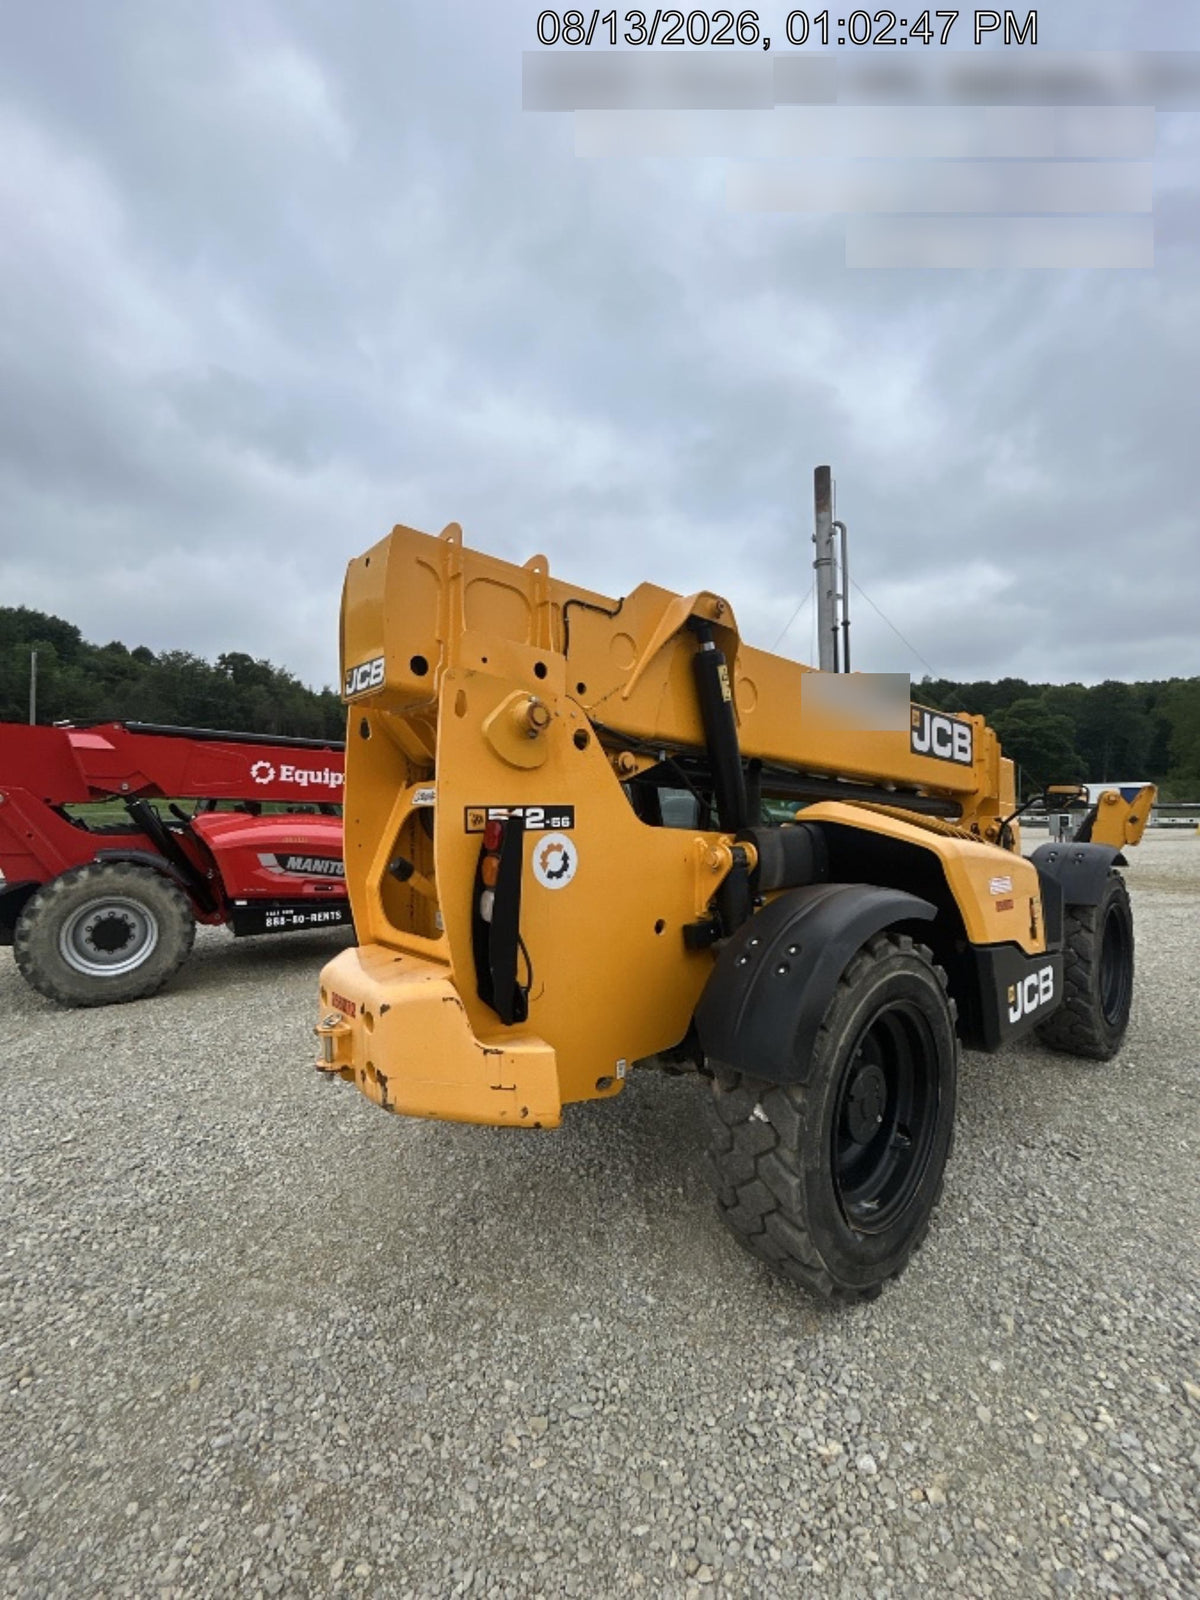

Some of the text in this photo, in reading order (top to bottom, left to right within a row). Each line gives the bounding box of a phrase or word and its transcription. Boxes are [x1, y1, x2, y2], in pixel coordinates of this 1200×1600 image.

[346, 657, 385, 695] JCB
[912, 712, 972, 762] JCB
[279, 764, 345, 788] Equip
[1008, 965, 1054, 1023] JCB
